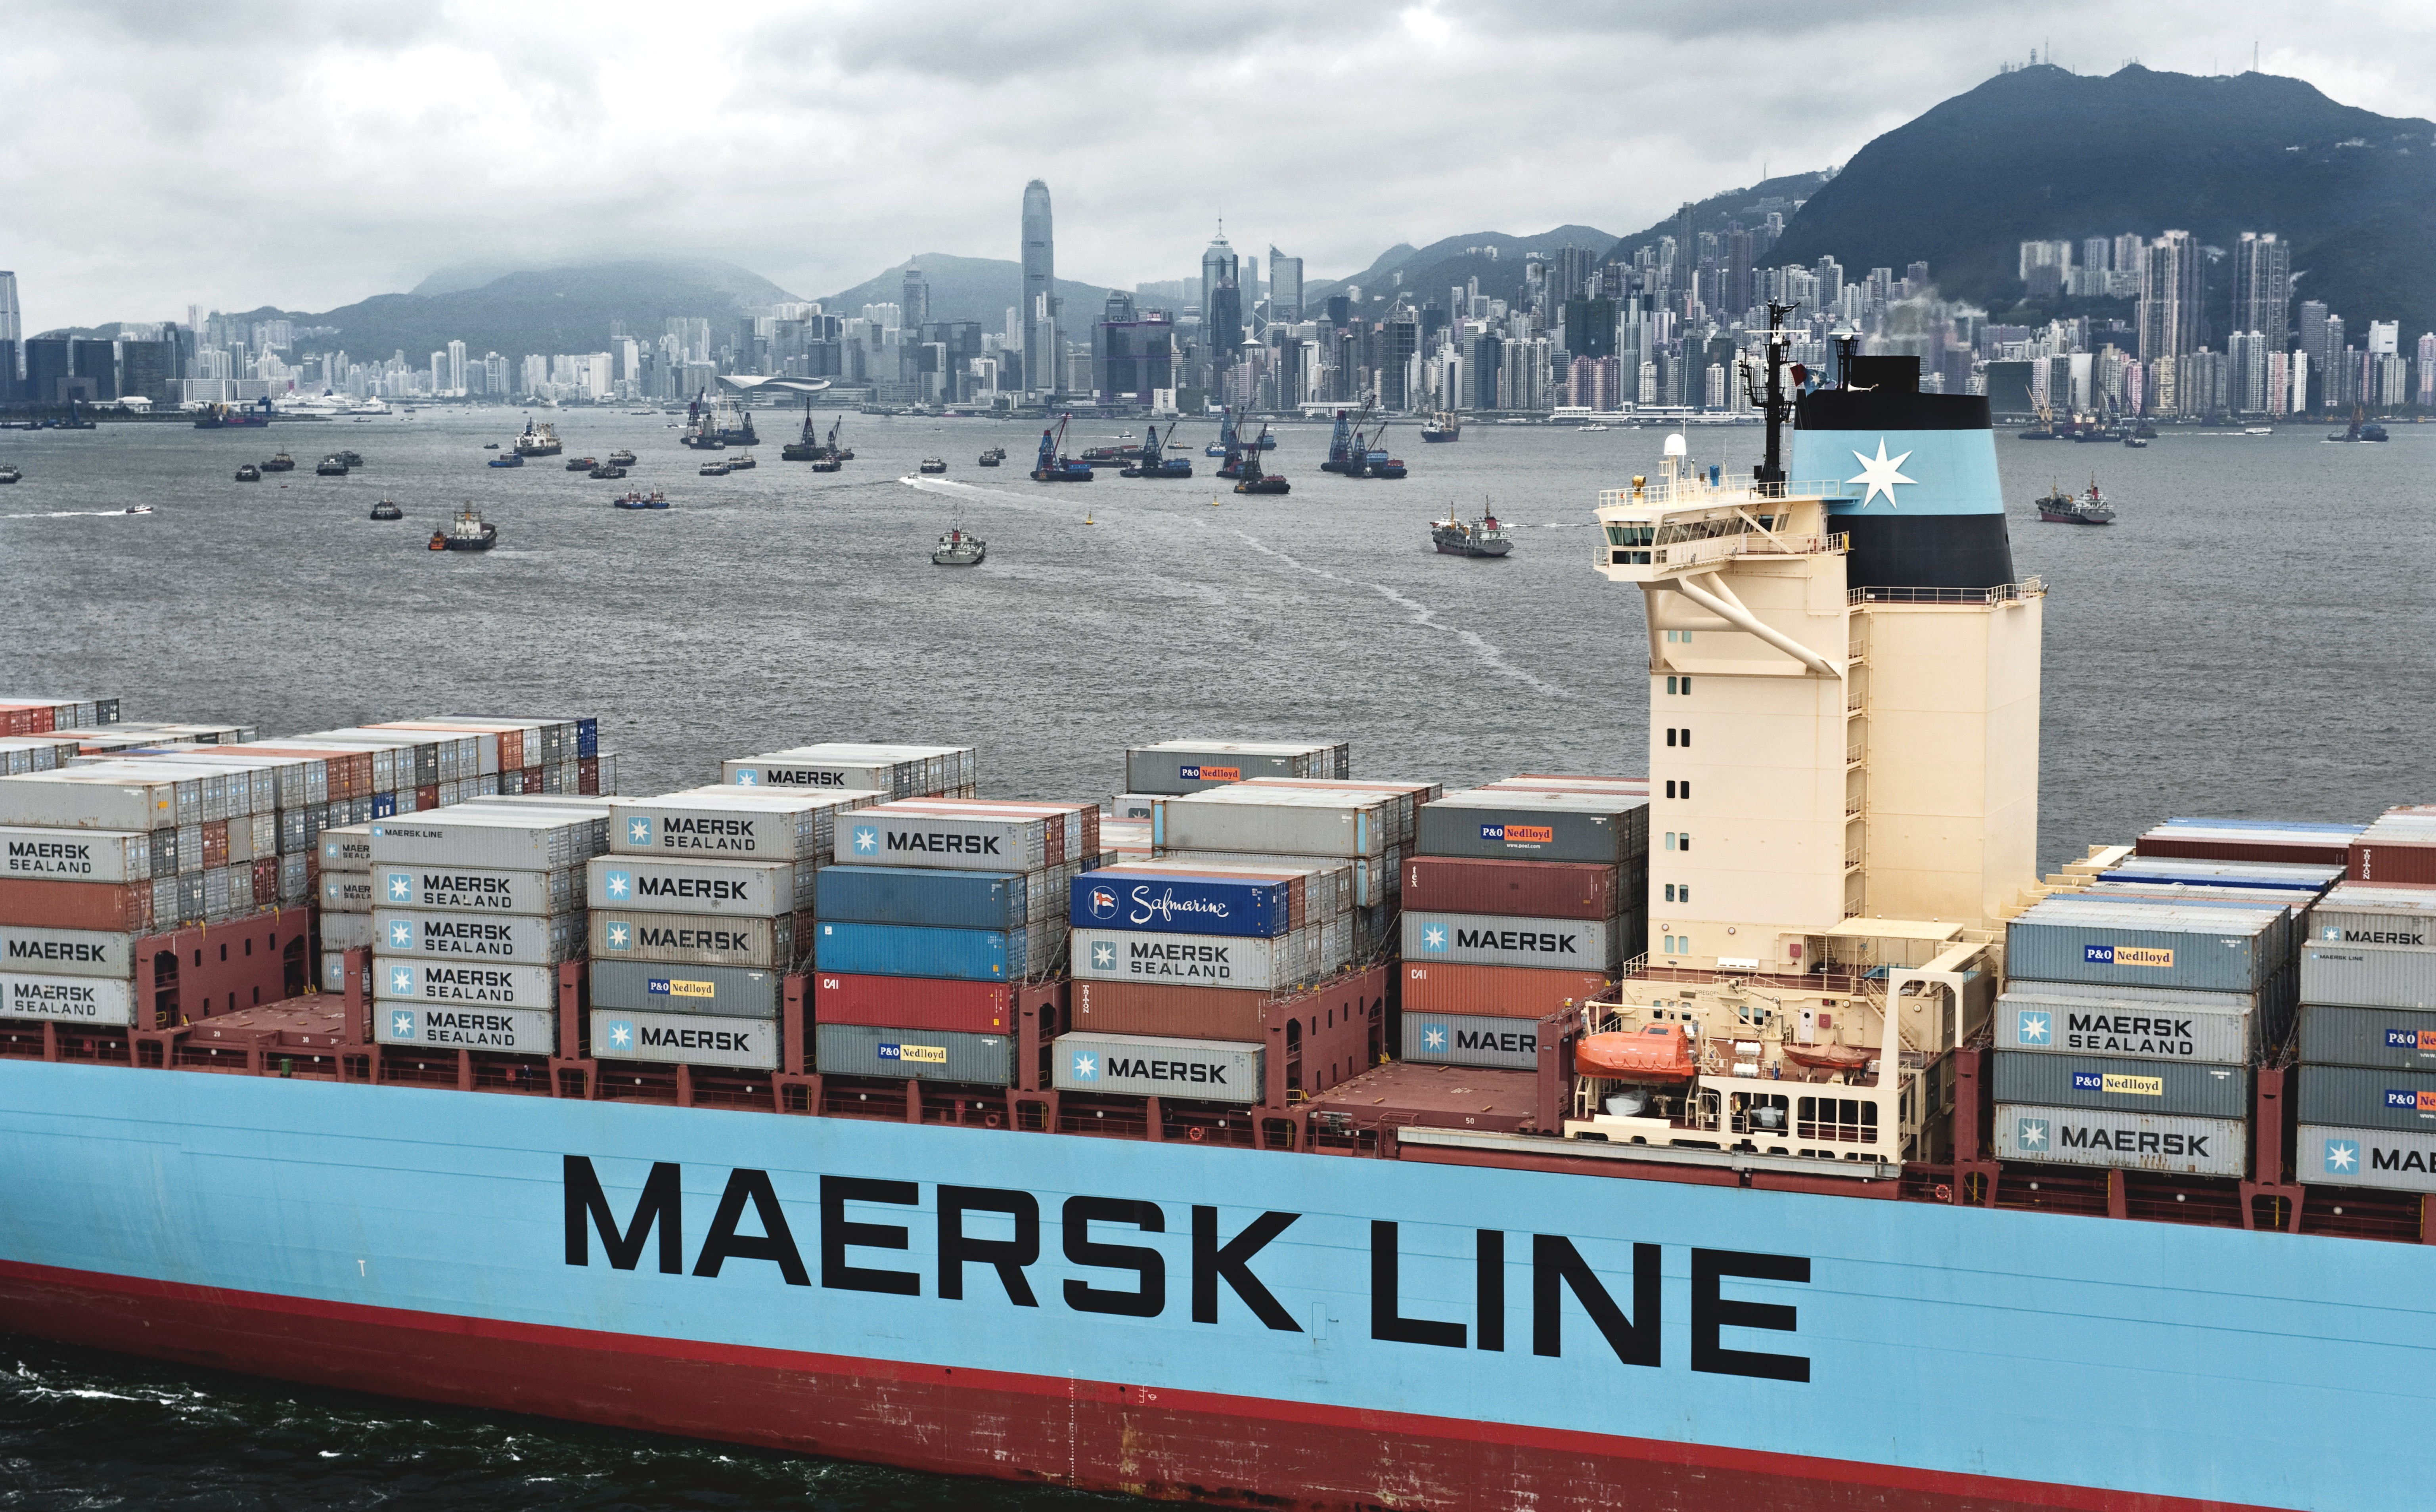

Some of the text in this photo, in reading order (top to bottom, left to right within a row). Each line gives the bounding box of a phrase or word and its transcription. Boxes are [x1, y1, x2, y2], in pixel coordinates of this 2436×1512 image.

[768, 770, 845, 785] MAERSK
[1182, 768, 1238, 779] P&O Nedlloyd
[385, 829, 421, 837] MAERSK
[664, 817, 755, 836] MAERSK
[1483, 828, 1550, 840] P&O Nedlloyd
[10, 842, 90, 859] MAERSK
[665, 835, 755, 850] SEALAND
[887, 831, 1001, 855] MAERSK
[10, 859, 91, 873] SEALAND
[2363, 848, 2371, 880] TRITON
[424, 875, 511, 894] MAERSK
[639, 877, 748, 900] MAERSK
[424, 893, 512, 908] SEALAND
[1130, 886, 1229, 924] Safmarine
[425, 921, 512, 940] MAERSK
[640, 928, 749, 951] MAERSK
[2346, 930, 2424, 945] MAERSK
[425, 939, 513, 955] SEALAND
[1457, 928, 1577, 953] MAERSK
[10, 940, 106, 962] MAERSK
[1131, 942, 1229, 963] MAERSK
[2087, 949, 2170, 964] P&O Nedlloyd
[426, 968, 513, 988] MAERSK
[1131, 961, 1230, 978] SEALAND
[15, 983, 95, 1002] MAERSK
[426, 985, 514, 1002] SEALAND
[651, 982, 712, 995] P&O Nedlloyd
[15, 1000, 96, 1016] SEALAND
[427, 1012, 513, 1032] MAERSK
[2069, 1013, 2193, 1038] MAERSK
[427, 1030, 515, 1046] SEALAND
[641, 1027, 751, 1052] MAERSK
[1457, 1030, 1536, 1053] MAER
[2069, 1034, 2193, 1055] SEALAND
[2389, 1033, 2415, 1044] P&O
[880, 1047, 944, 1060] P&O Nedlloyd
[1109, 1057, 1228, 1084] MAERSK
[2076, 1076, 2159, 1092] P&O Nedlloyd
[2388, 1094, 2415, 1105] P&O
[2061, 1126, 2210, 1157] MAERSK
[563, 1154, 1812, 1384] MAERSK LINE
